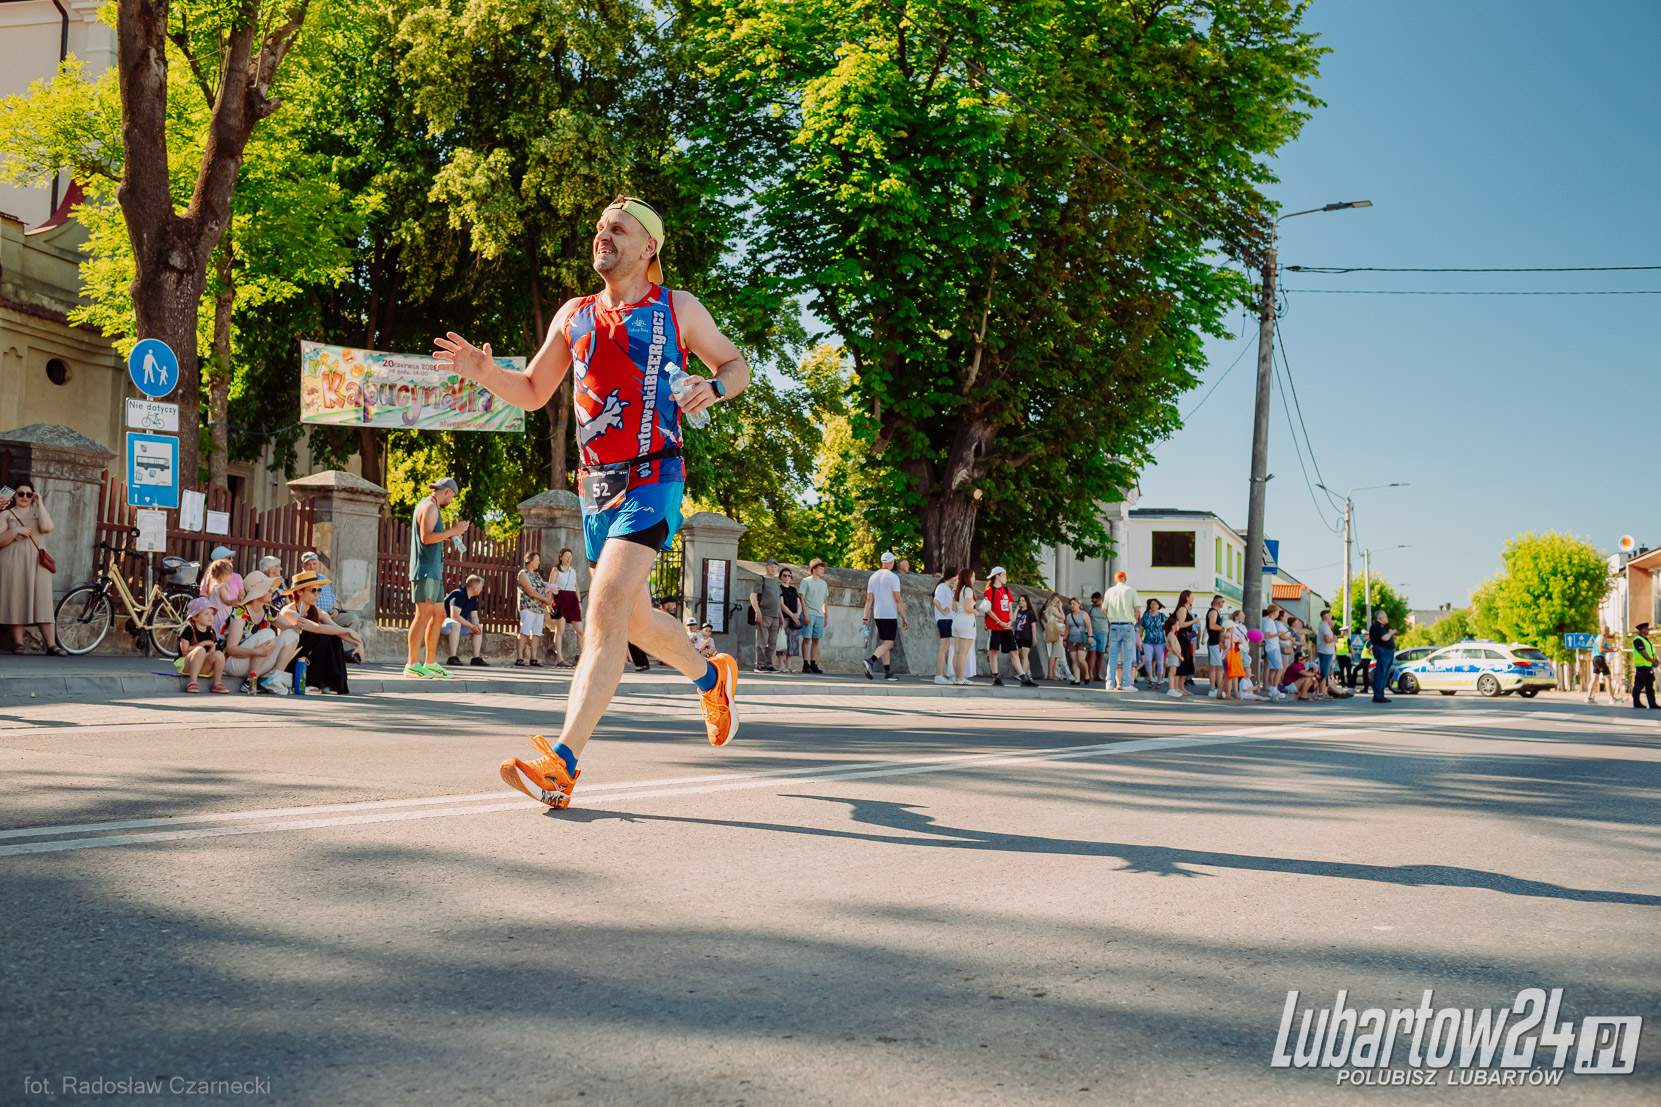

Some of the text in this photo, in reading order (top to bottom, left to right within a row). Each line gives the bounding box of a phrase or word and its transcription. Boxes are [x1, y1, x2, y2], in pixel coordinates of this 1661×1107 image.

[382, 360, 394, 368] 20
[637, 310, 667, 478] uartowskiBEERgacz
[129, 400, 176, 416] Nie dotyczy
[592, 482, 611, 498] 52
